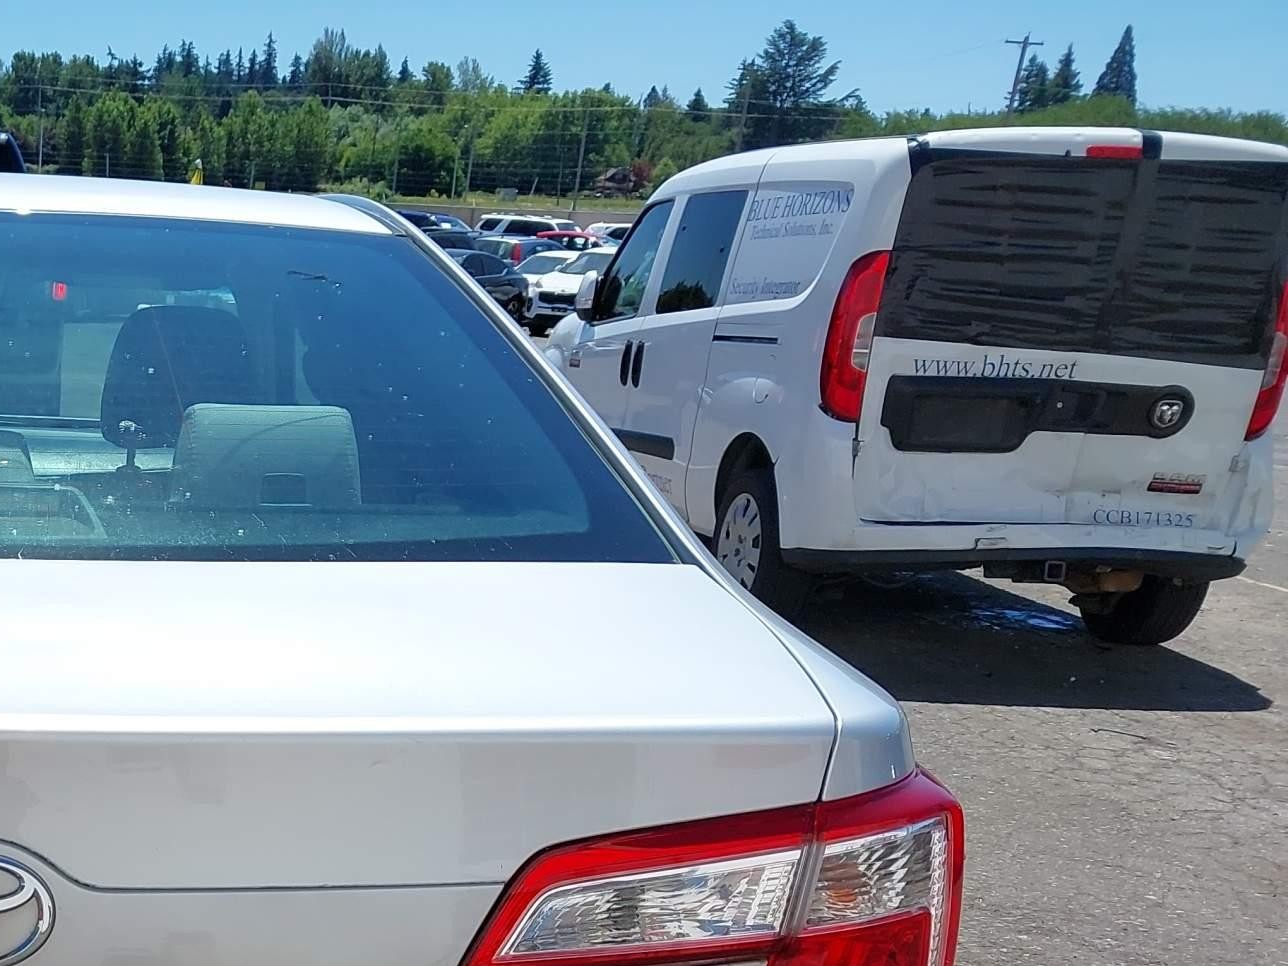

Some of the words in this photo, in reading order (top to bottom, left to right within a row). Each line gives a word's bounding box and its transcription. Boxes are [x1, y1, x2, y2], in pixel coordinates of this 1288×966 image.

[747, 196, 783, 222] BLUE
[780, 188, 854, 218] HORIZONS
[913, 354, 1078, 379] www.bhts.net
[1093, 508, 1196, 528] CCB171325
